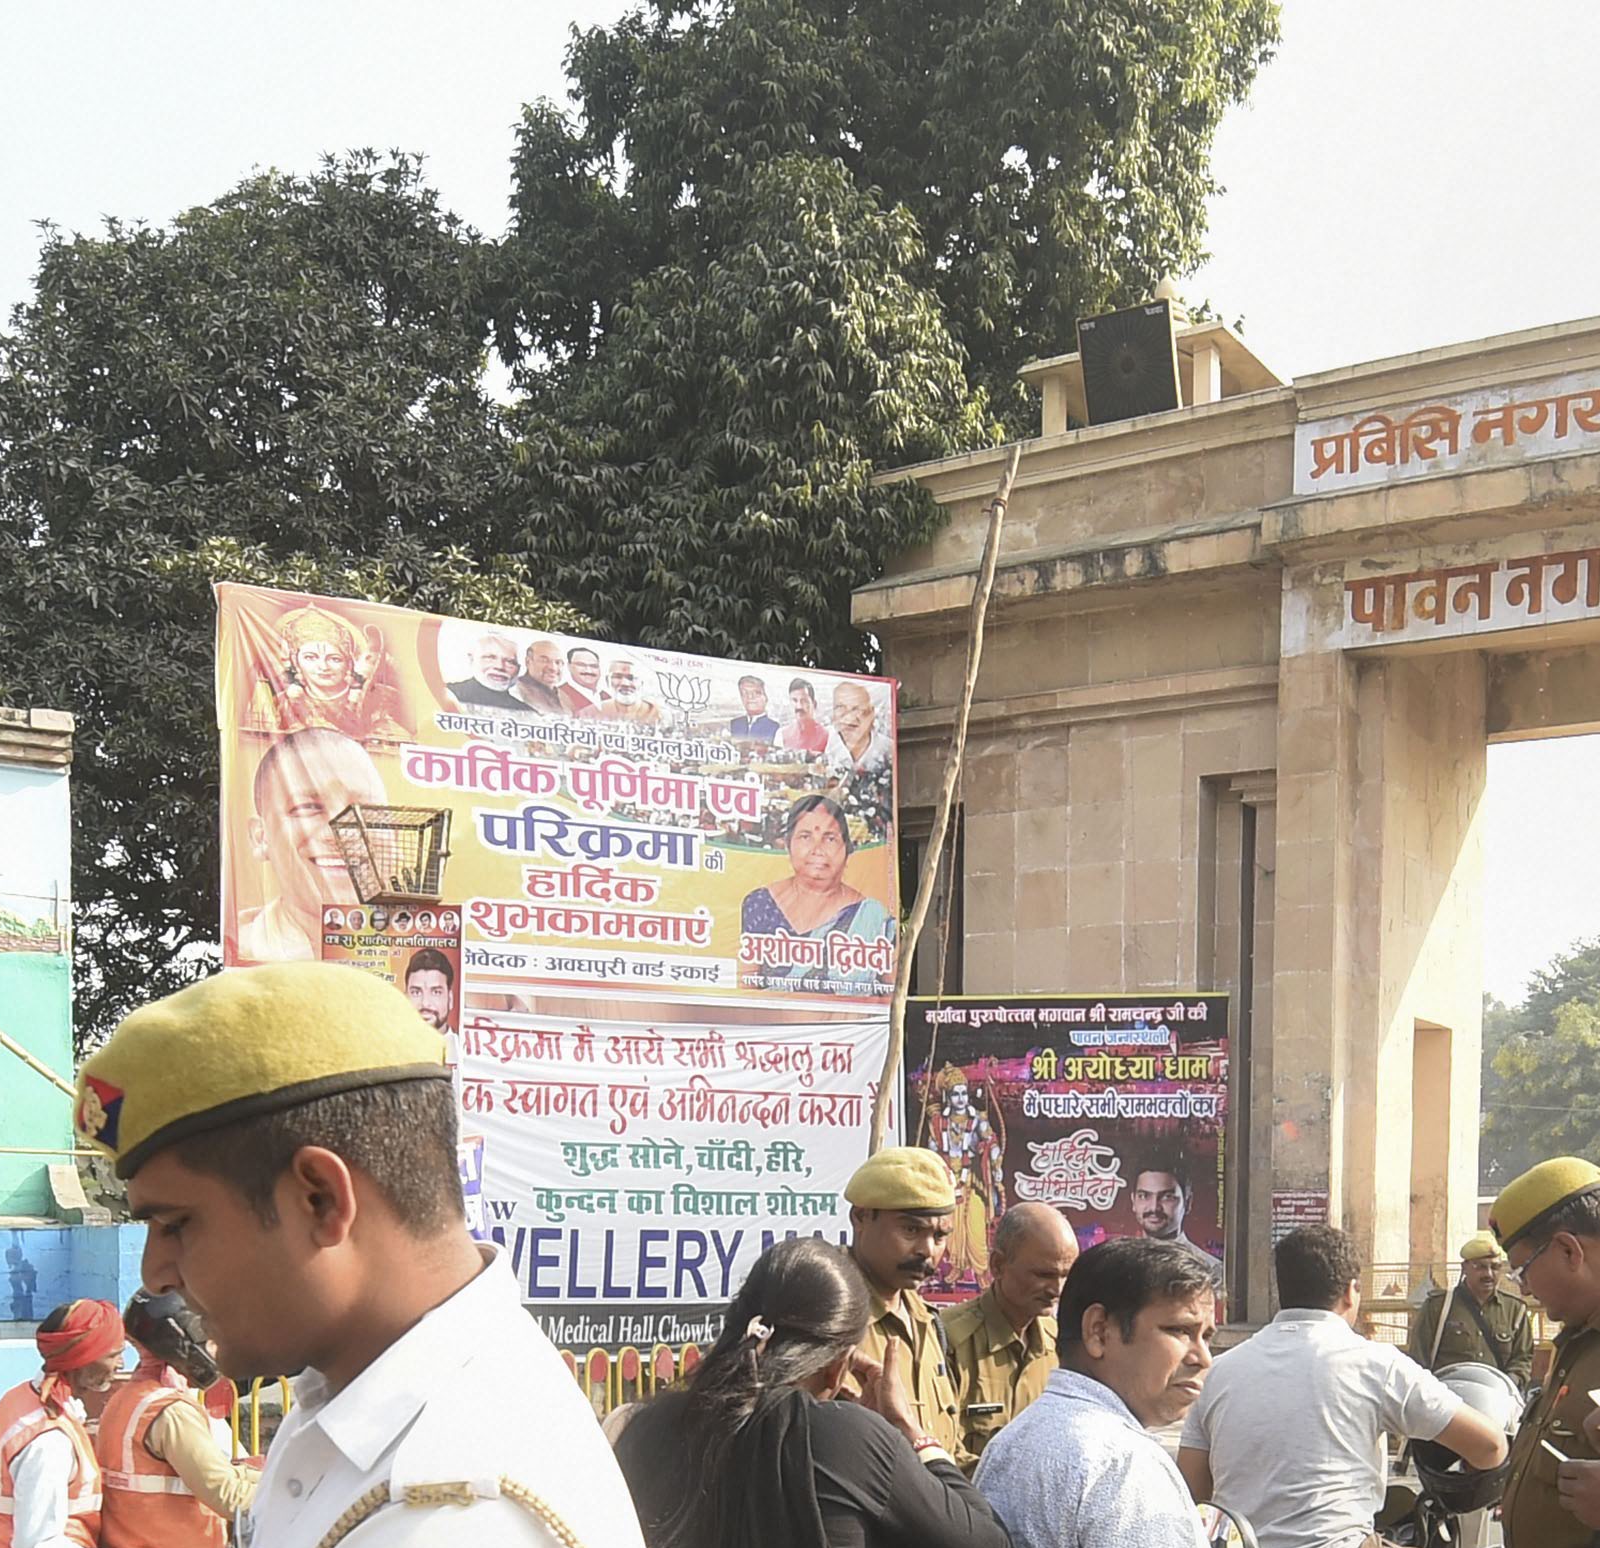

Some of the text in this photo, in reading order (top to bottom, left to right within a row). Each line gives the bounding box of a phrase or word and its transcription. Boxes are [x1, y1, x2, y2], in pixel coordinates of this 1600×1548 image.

[436, 713, 495, 735] समस्त
[406, 744, 557, 795] कार्तिक
[568, 759, 699, 812] पूर्णिमा
[479, 805, 725, 872] परिक्रमा की
[525, 863, 658, 903] हार्दिक
[470, 900, 709, 944] शुभकामनाएं
[740, 931, 823, 966] अशोका
[670, 963, 721, 983] इकाई
[1038, 1007, 1087, 1023] भगवान
[1089, 1003, 1106, 1023] श्री
[1166, 1002, 1185, 1022] जी
[1187, 1001, 1208, 1022] की
[819, 1042, 856, 1074] का
[1032, 1047, 1059, 1081] श्री
[1063, 1051, 1157, 1081] अयोध्या
[502, 1079, 600, 1118] स्वागत
[798, 1092, 863, 1127] करता
[532, 1186, 619, 1223] कुन्दन
[624, 1189, 666, 1215] का
[670, 1183, 761, 1216] विशाल
[547, 1318, 615, 1345] Medical
